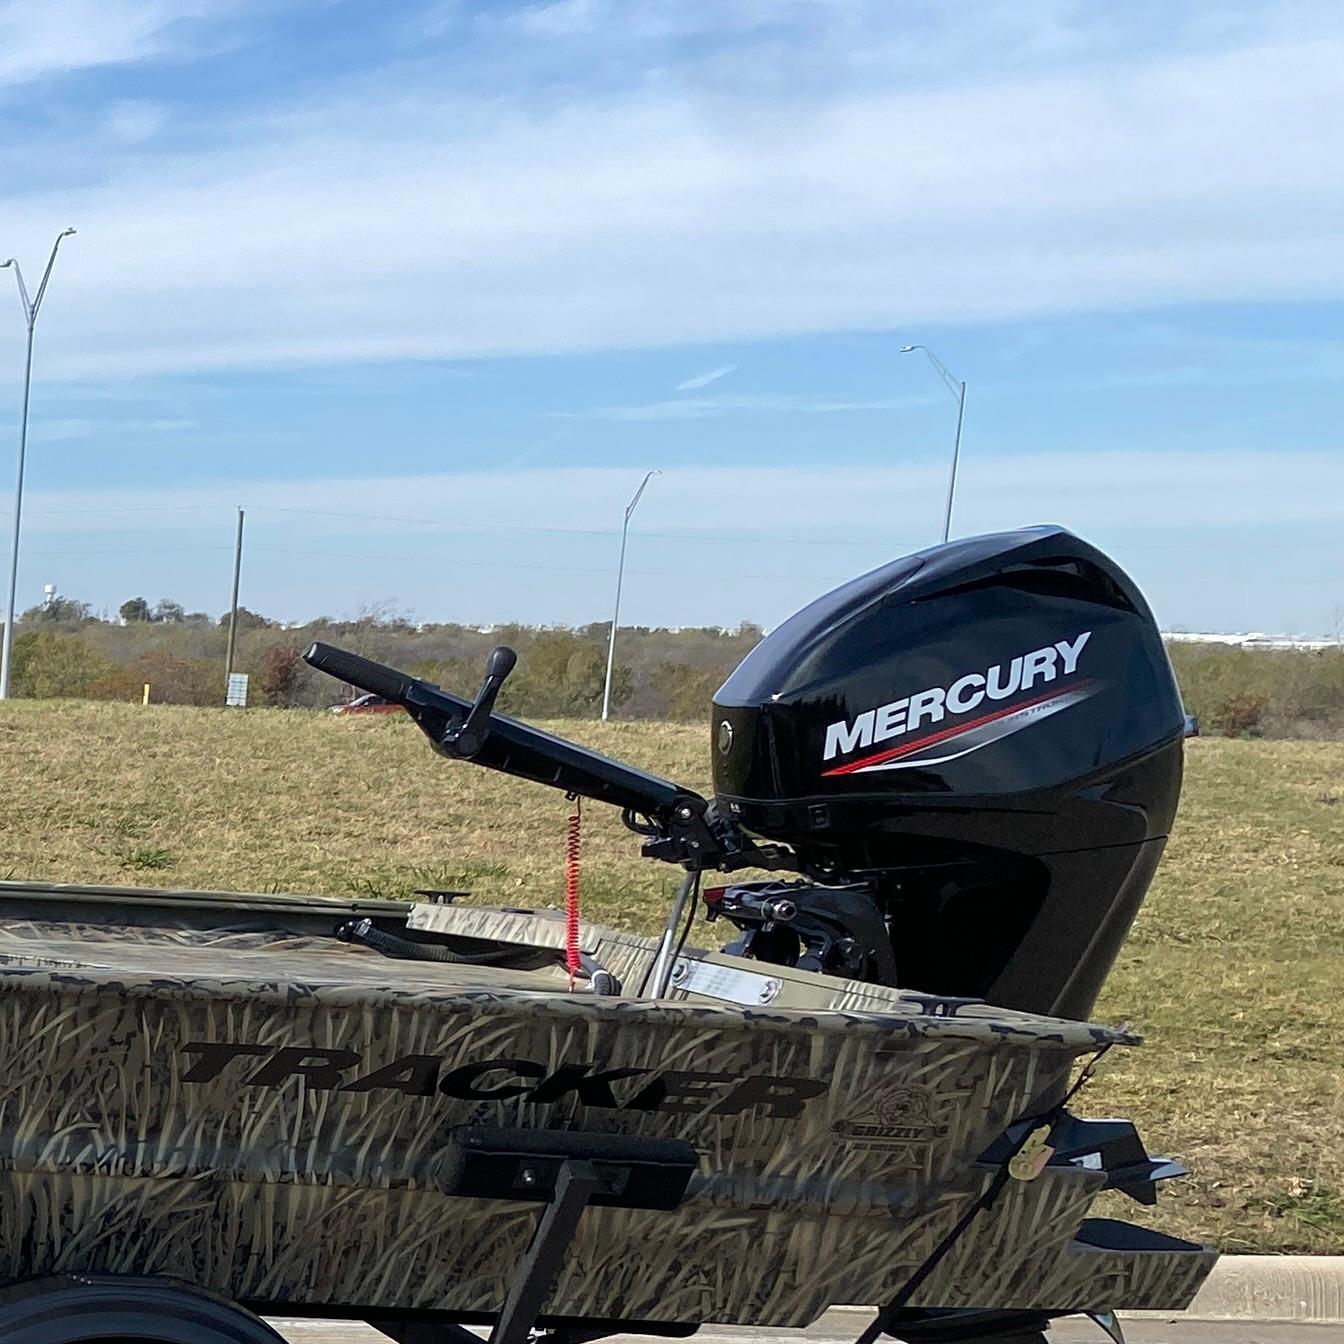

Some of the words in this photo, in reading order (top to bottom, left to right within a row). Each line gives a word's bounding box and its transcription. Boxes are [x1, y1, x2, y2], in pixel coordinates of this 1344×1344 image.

[823, 631, 1092, 761] MERCURY
[179, 1041, 829, 1119] TRACKER
[850, 1125, 925, 1138] GRIZZLY
